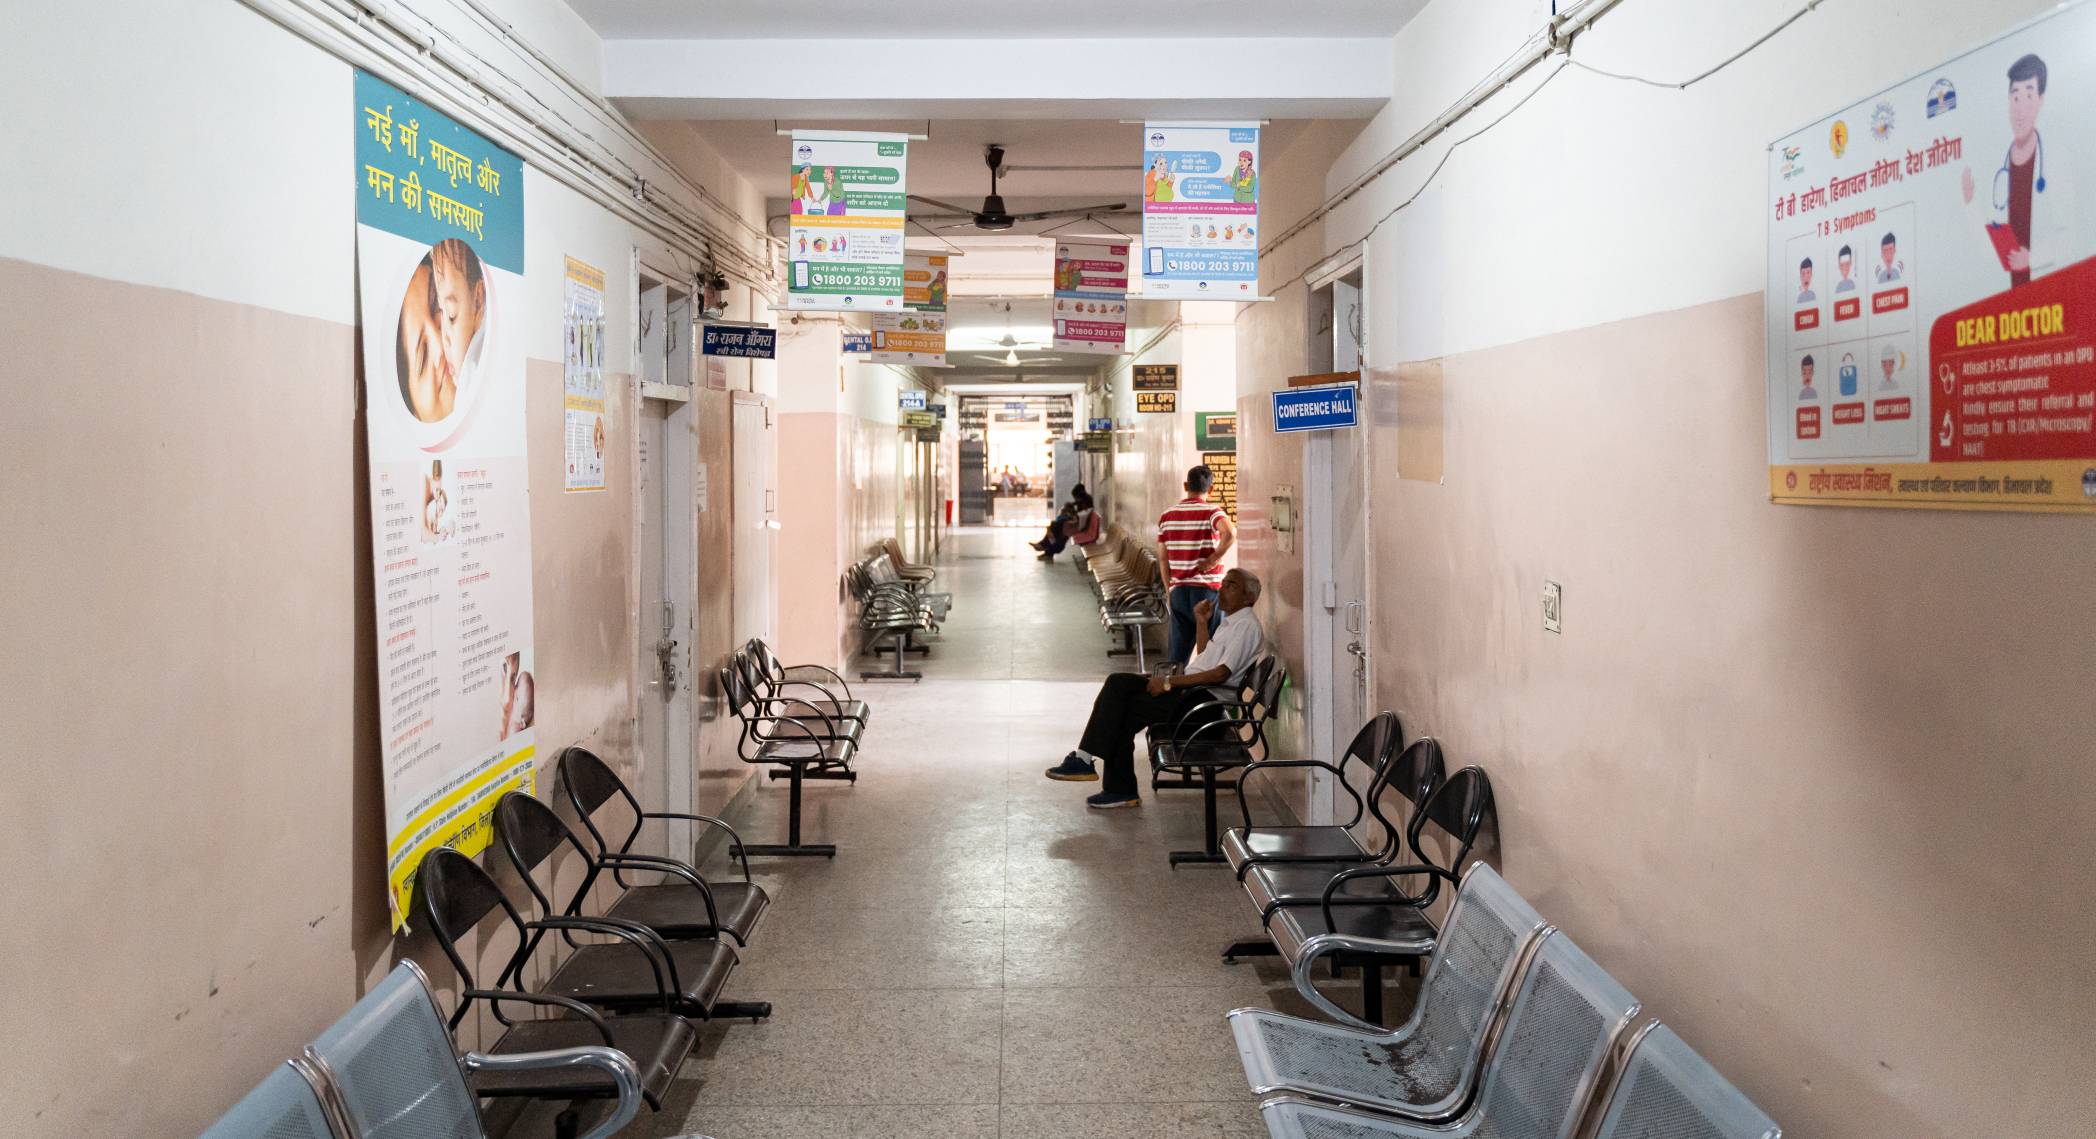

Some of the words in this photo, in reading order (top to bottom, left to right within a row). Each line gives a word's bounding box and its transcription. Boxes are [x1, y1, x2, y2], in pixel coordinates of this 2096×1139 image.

[364, 105, 392, 152] नई
[429, 138, 472, 188] मातृत्व
[476, 157, 500, 196] और
[1775, 197, 1784, 221] टी
[1786, 192, 1796, 217] बी
[1800, 185, 1828, 213] हारेगा,
[1829, 176, 1867, 203] हिमाचल
[1869, 158, 1903, 189] जीतेगा,
[1905, 148, 1924, 176] देश
[1926, 136, 1962, 169] जीतेगा
[365, 165, 394, 203] मन
[400, 171, 422, 213] की
[427, 189, 484, 241] समस्याएं
[1817, 222, 1823, 238] T
[1824, 220, 1830, 236] B
[1833, 207, 1876, 234] Symptoms
[1179, 261, 1206, 271] 1800
[1208, 261, 1229, 271] 203
[1232, 261, 1254, 272] 9711
[823, 274, 851, 285] 1800
[854, 275, 876, 286] 203
[878, 276, 901, 287] 9711
[1956, 315, 1996, 347] DEAR
[1999, 304, 2064, 341] DOCTOR
[1962, 360, 1988, 375] Atleast
[2008, 355, 2017, 370] of
[2019, 352, 2052, 372] patients
[2053, 352, 2062, 365] in
[2063, 351, 2075, 364] an
[2076, 346, 2094, 363] OPD
[1962, 384, 1974, 396] are
[1975, 381, 1997, 395] chest
[1997, 375, 2049, 395] symptomatic
[1138, 394, 1155, 403] EYE
[1157, 394, 1175, 403] OPD
[1278, 401, 1330, 418] CONFERENCE
[1331, 399, 1352, 414] HALL
[1988, 400, 2015, 414] ensure
[2018, 397, 2037, 411] their
[2041, 393, 2073, 410] referral
[2077, 391, 2094, 408] and
[1962, 422, 1989, 438] testing
